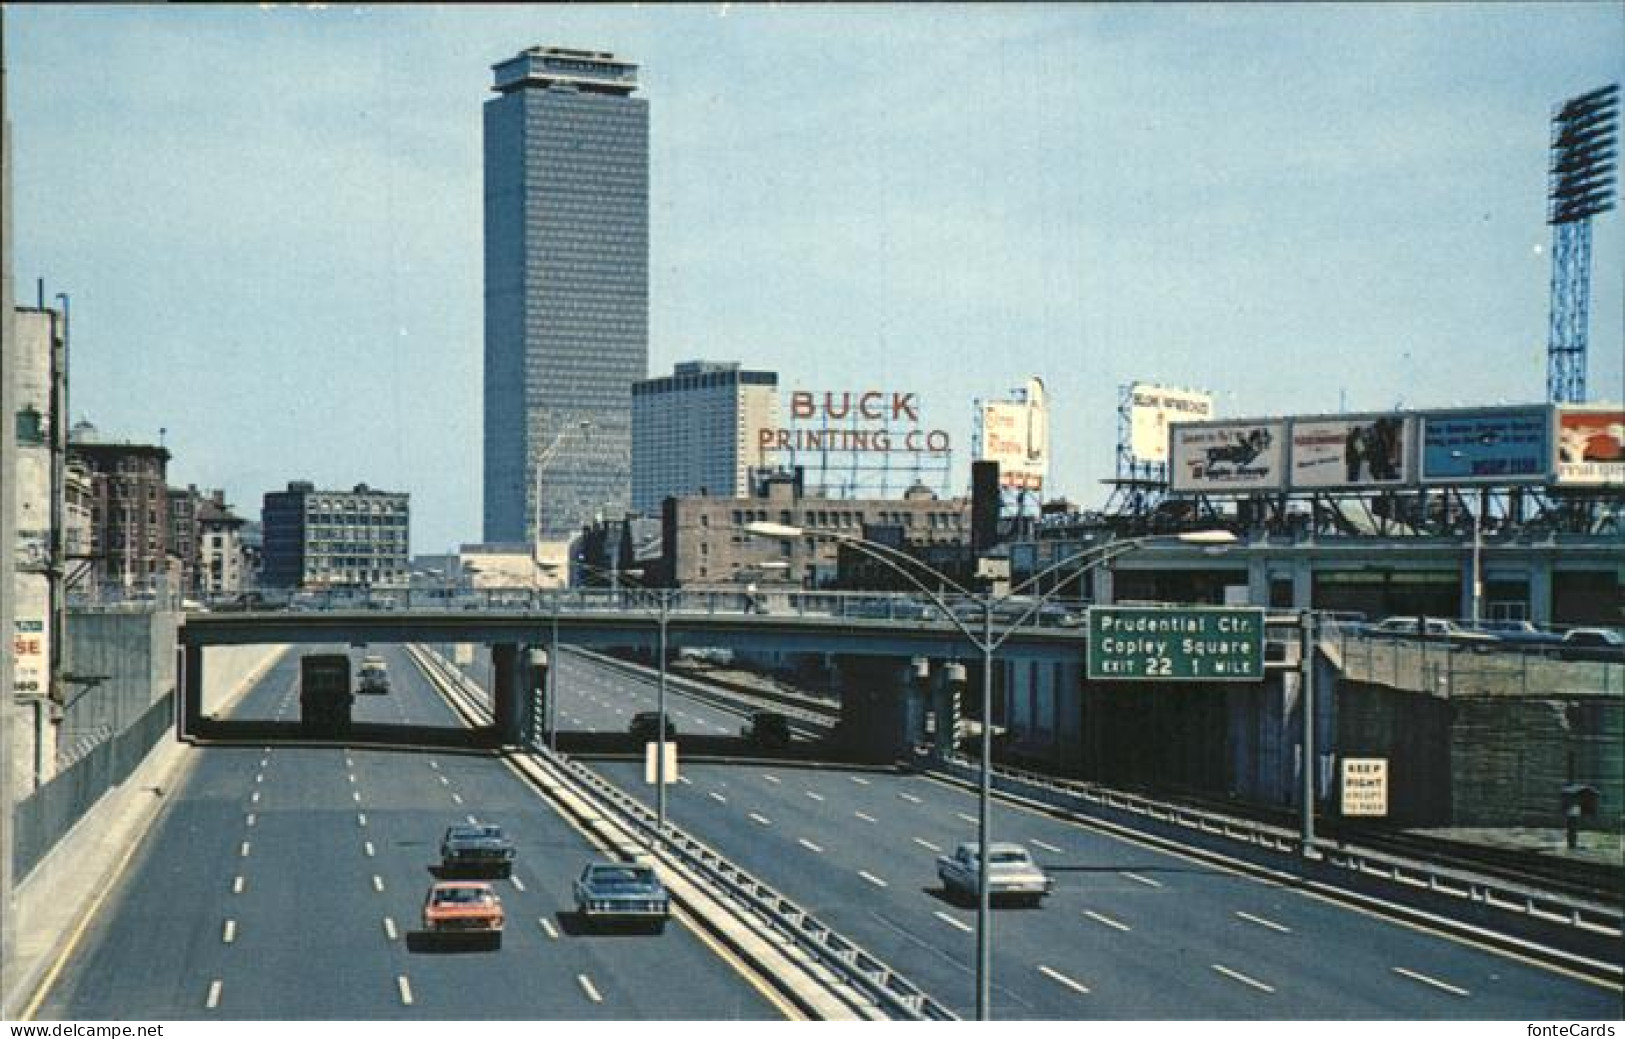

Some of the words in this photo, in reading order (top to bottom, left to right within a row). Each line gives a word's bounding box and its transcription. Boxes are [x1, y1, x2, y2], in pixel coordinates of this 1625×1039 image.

[791, 391, 919, 421] BUCK
[758, 427, 890, 451] PRINTING
[906, 429, 950, 451] CO
[1101, 616, 1205, 632] Prudential
[1101, 637, 1167, 657] Copley
[1182, 638, 1251, 657] Square
[1102, 660, 1135, 673] EXIT
[1145, 657, 1173, 675] 22
[1192, 659, 1198, 675] 1
[1215, 661, 1251, 673] MILE
[1347, 764, 1382, 773] KEEP
[1346, 778, 1382, 787] RIGHT
